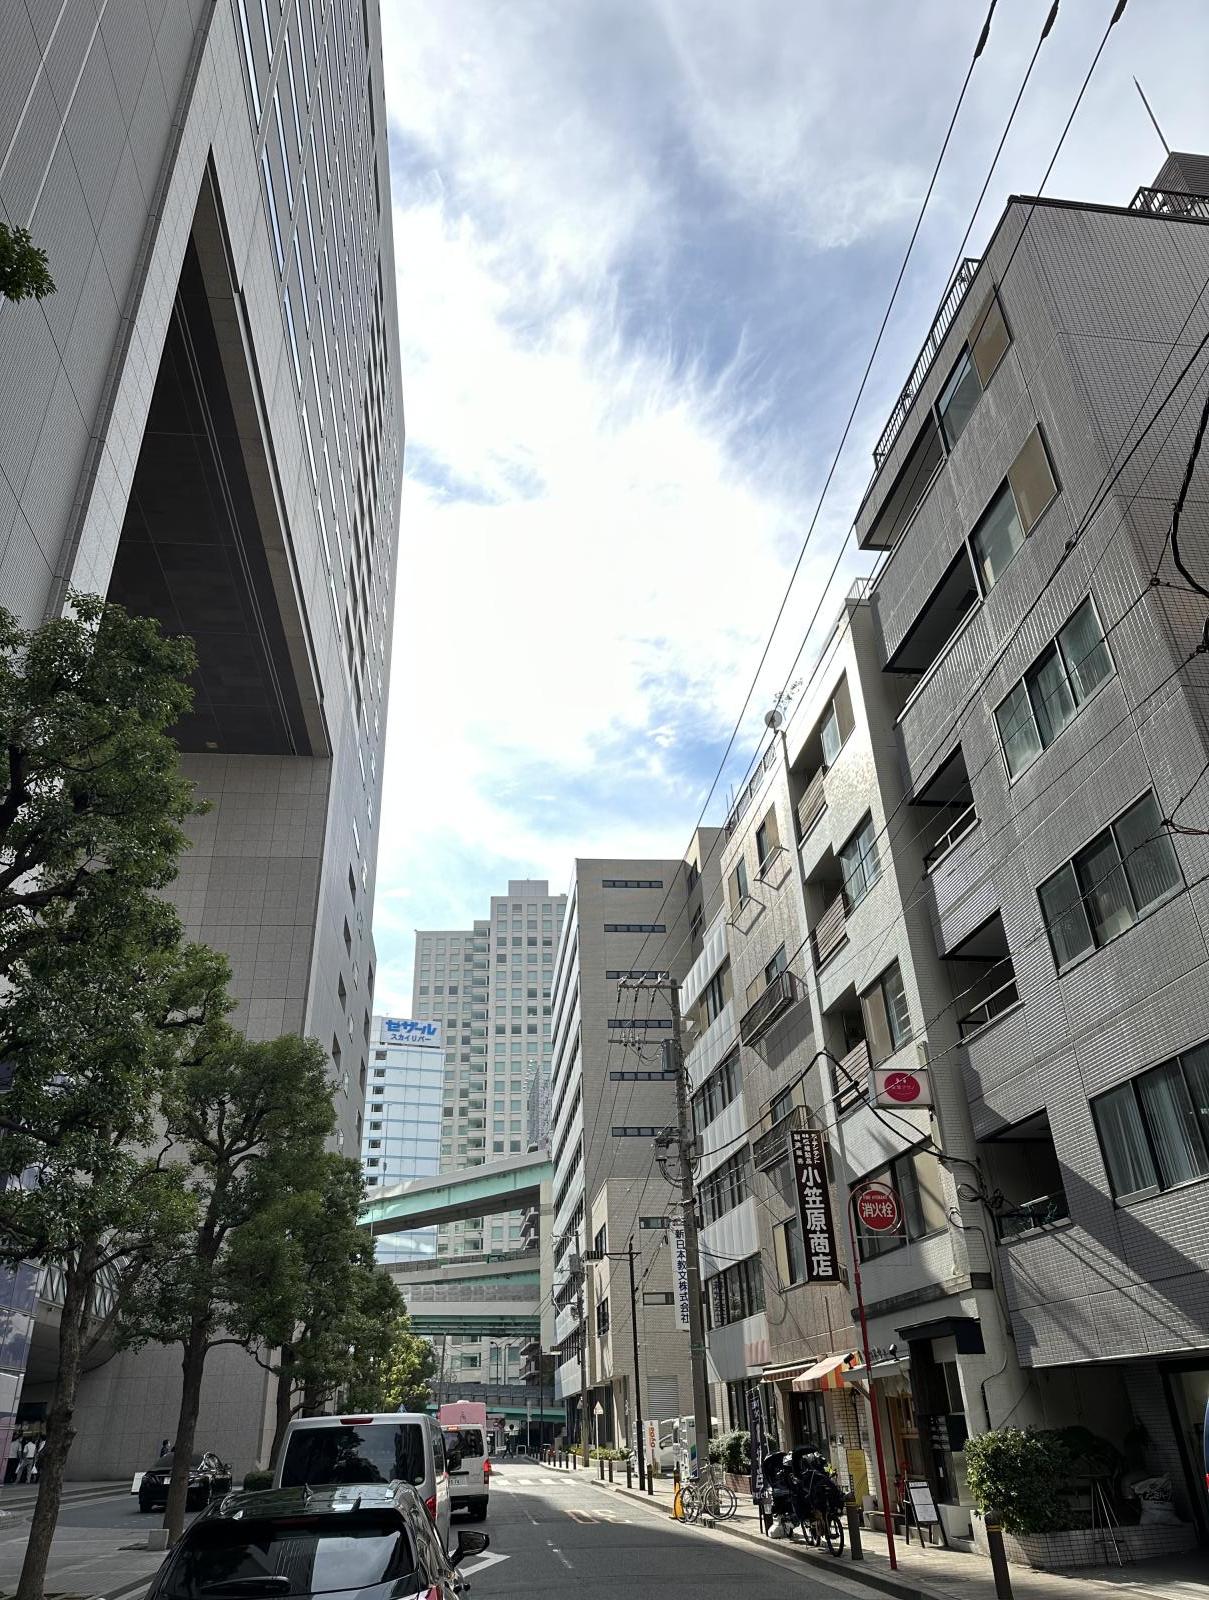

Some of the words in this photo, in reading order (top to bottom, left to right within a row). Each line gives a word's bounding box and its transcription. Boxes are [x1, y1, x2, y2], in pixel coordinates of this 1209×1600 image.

[385, 1019, 437, 1036] セザール
[390, 1033, 432, 1042] スカイリバー
[861, 1201, 894, 1218] 消火栓
[801, 1166, 833, 1277] 小笠原商店
